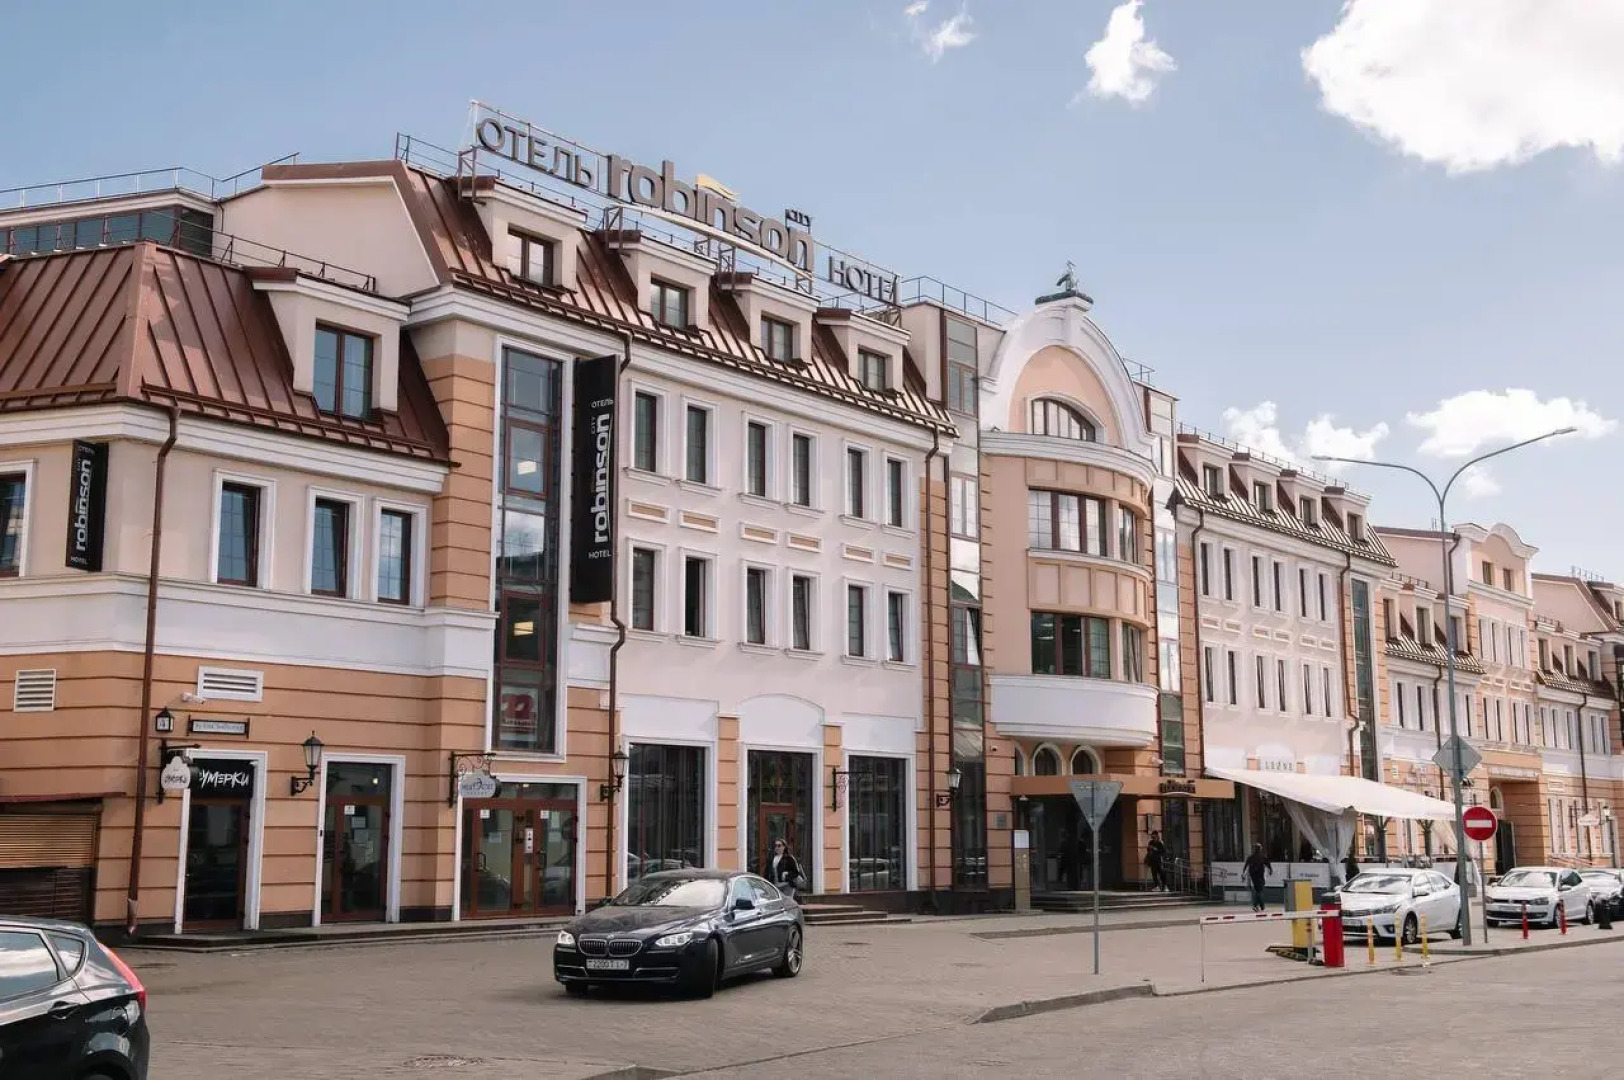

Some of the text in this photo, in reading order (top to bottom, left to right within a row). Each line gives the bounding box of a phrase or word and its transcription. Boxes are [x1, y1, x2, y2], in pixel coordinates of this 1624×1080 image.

[476, 117, 595, 190] ОТЕЛЬ
[607, 153, 814, 272] robinson
[74, 459, 91, 552] robinson
[590, 413, 610, 543] robinson
[588, 550, 612, 559] HOTEL
